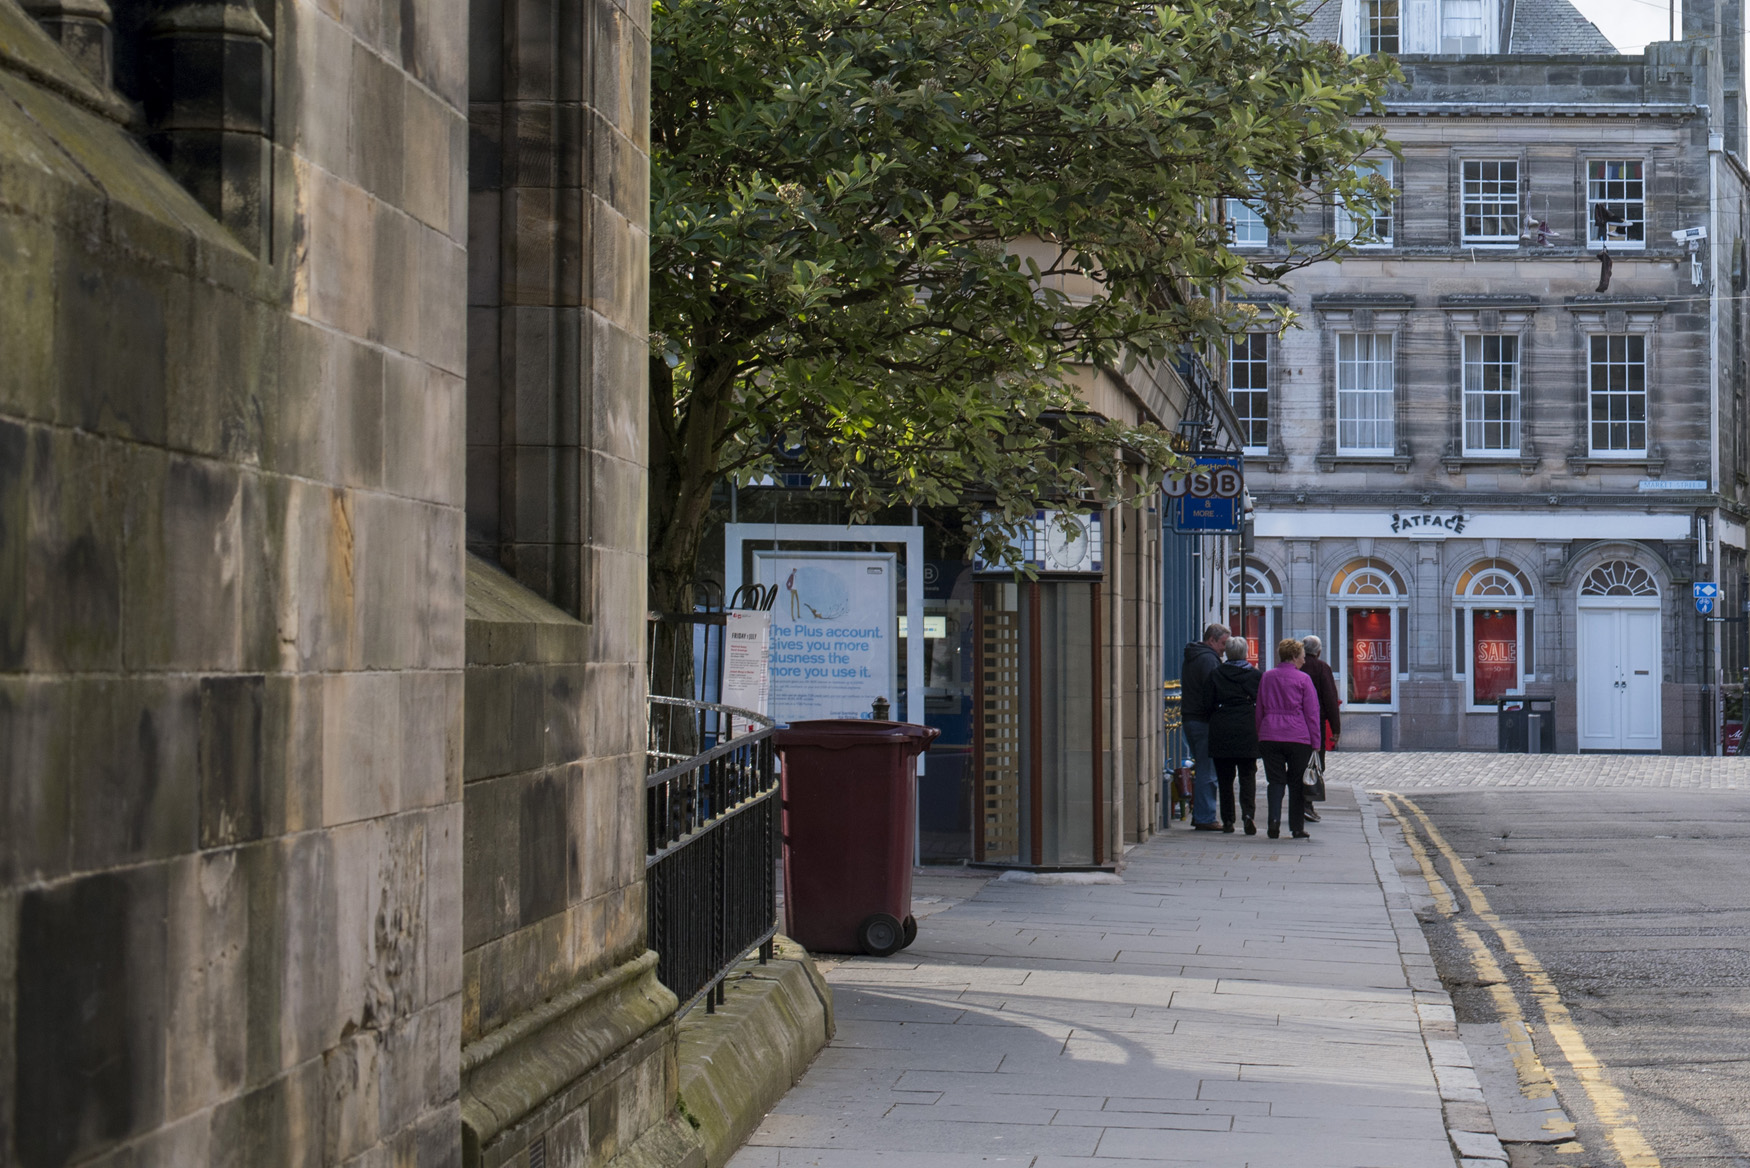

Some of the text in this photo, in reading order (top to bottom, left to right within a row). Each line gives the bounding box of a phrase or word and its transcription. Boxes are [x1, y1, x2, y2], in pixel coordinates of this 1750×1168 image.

[731, 632, 747, 640] FRIDAY
[795, 624, 824, 638] Plus
[826, 626, 883, 639] account.
[806, 640, 831, 653] you
[834, 641, 869, 652] more
[1356, 641, 1391, 661] SALE
[1478, 642, 1516, 661] SALE
[828, 652, 850, 664] the
[769, 666, 872, 679] more you use it.
